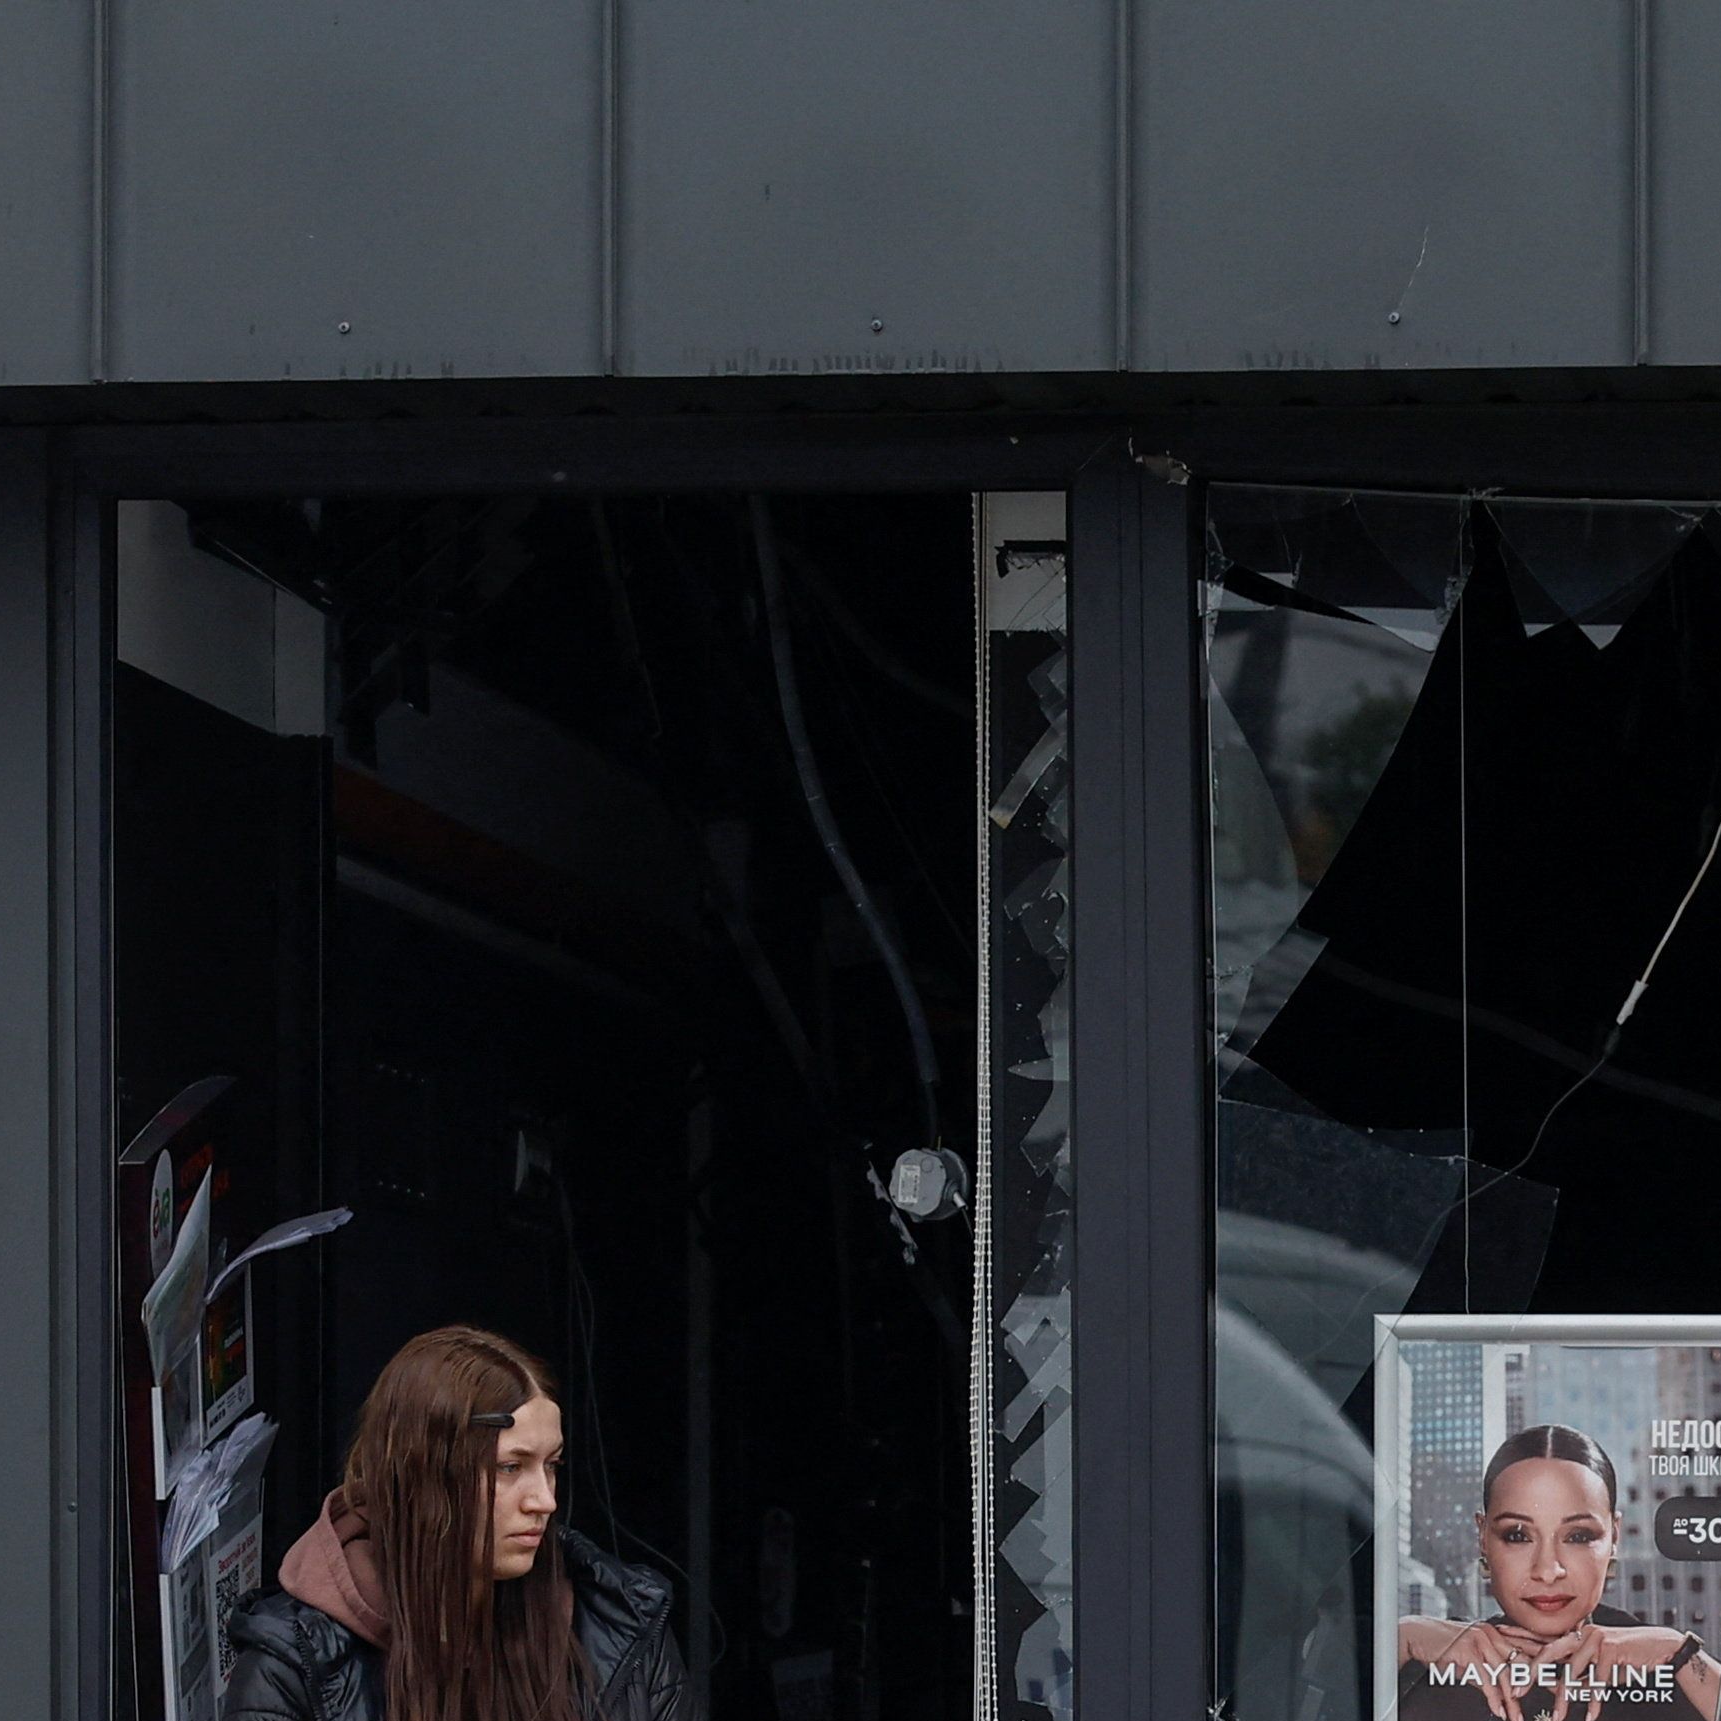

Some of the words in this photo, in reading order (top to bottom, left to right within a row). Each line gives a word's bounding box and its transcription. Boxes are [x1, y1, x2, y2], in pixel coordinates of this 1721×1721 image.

[1649, 1455, 1690, 1476] ТВОЯ
[1428, 1662, 1675, 1689] MAYBELLINE
[1565, 1689, 1612, 1702] NEW
[1616, 1690, 1674, 1703] YORK
